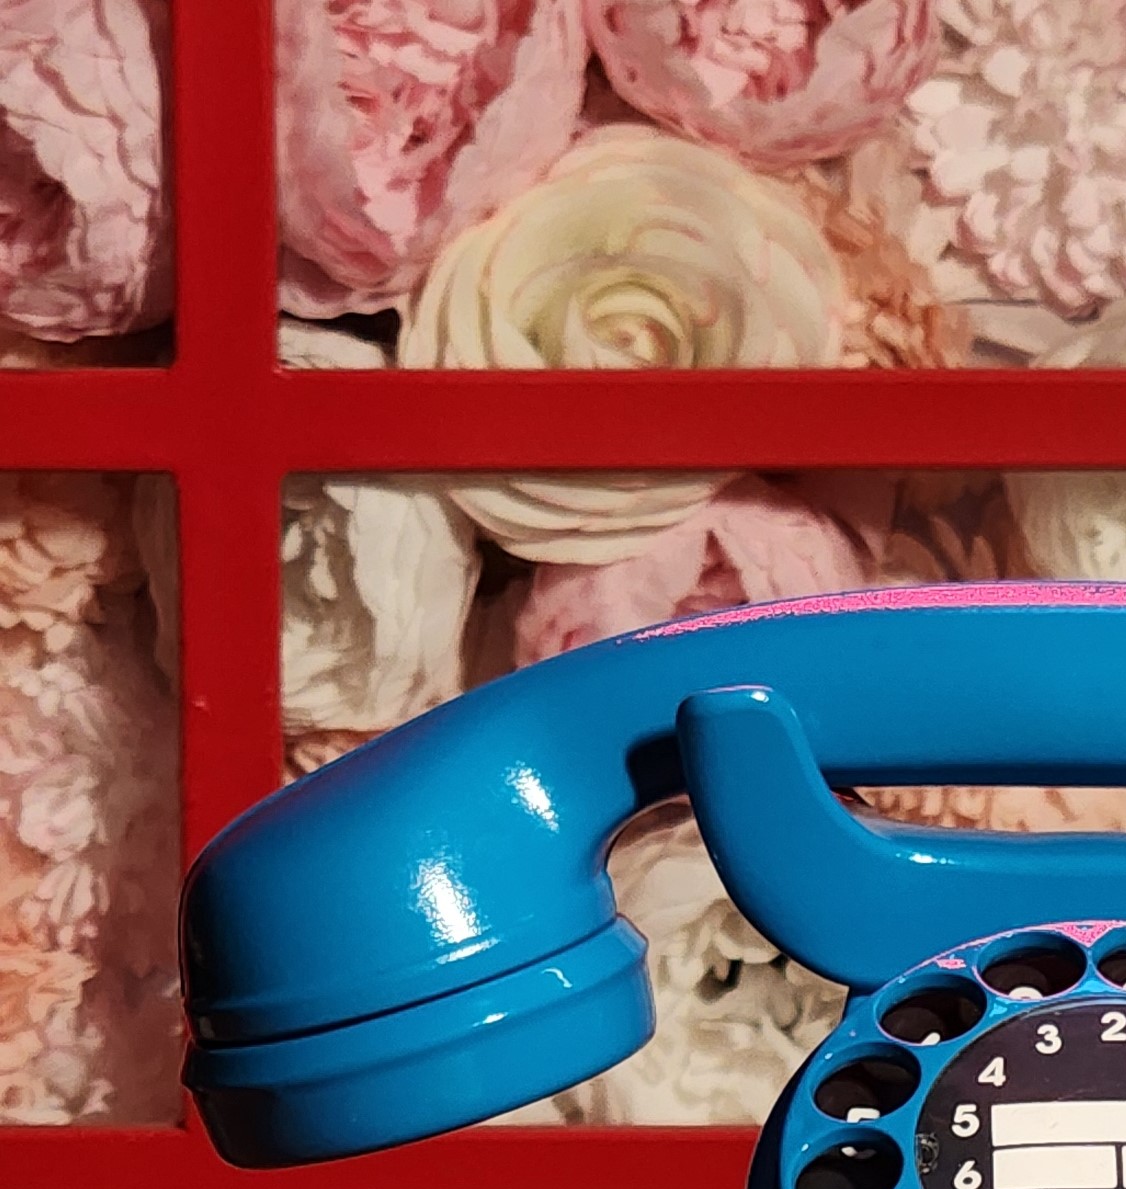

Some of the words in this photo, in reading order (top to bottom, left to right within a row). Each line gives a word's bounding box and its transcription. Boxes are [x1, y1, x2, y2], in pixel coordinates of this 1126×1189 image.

[1034, 1023, 1063, 1055] 3
[977, 1056, 1007, 1087] 4
[951, 1103, 980, 1138] 5
